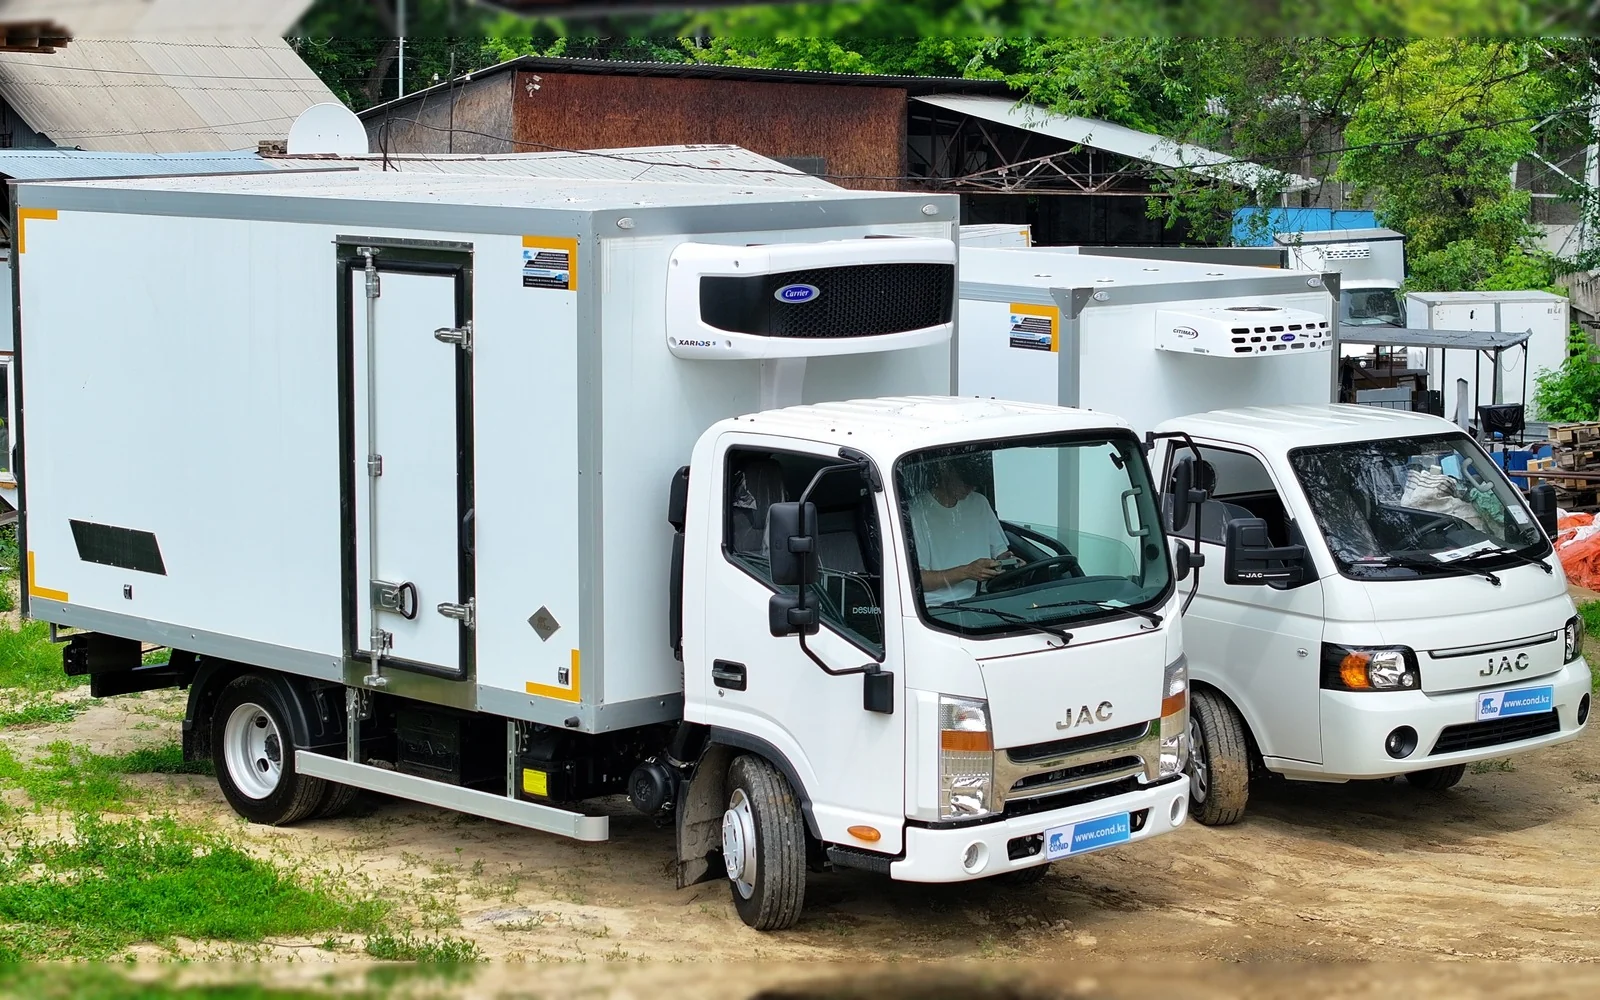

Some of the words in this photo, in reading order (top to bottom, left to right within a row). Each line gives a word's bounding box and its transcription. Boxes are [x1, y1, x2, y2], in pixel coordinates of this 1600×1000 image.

[785, 289, 809, 298] Carrier
[1172, 328, 1195, 337] CITIMAX
[678, 339, 711, 347] XARIOS
[1479, 652, 1529, 676] JAC
[1503, 695, 1550, 708] www.cond.kz
[1055, 700, 1113, 730] JAC
[1481, 706, 1498, 714] COND
[1074, 823, 1126, 843] www.cond.kz
[1049, 841, 1069, 853] COND
